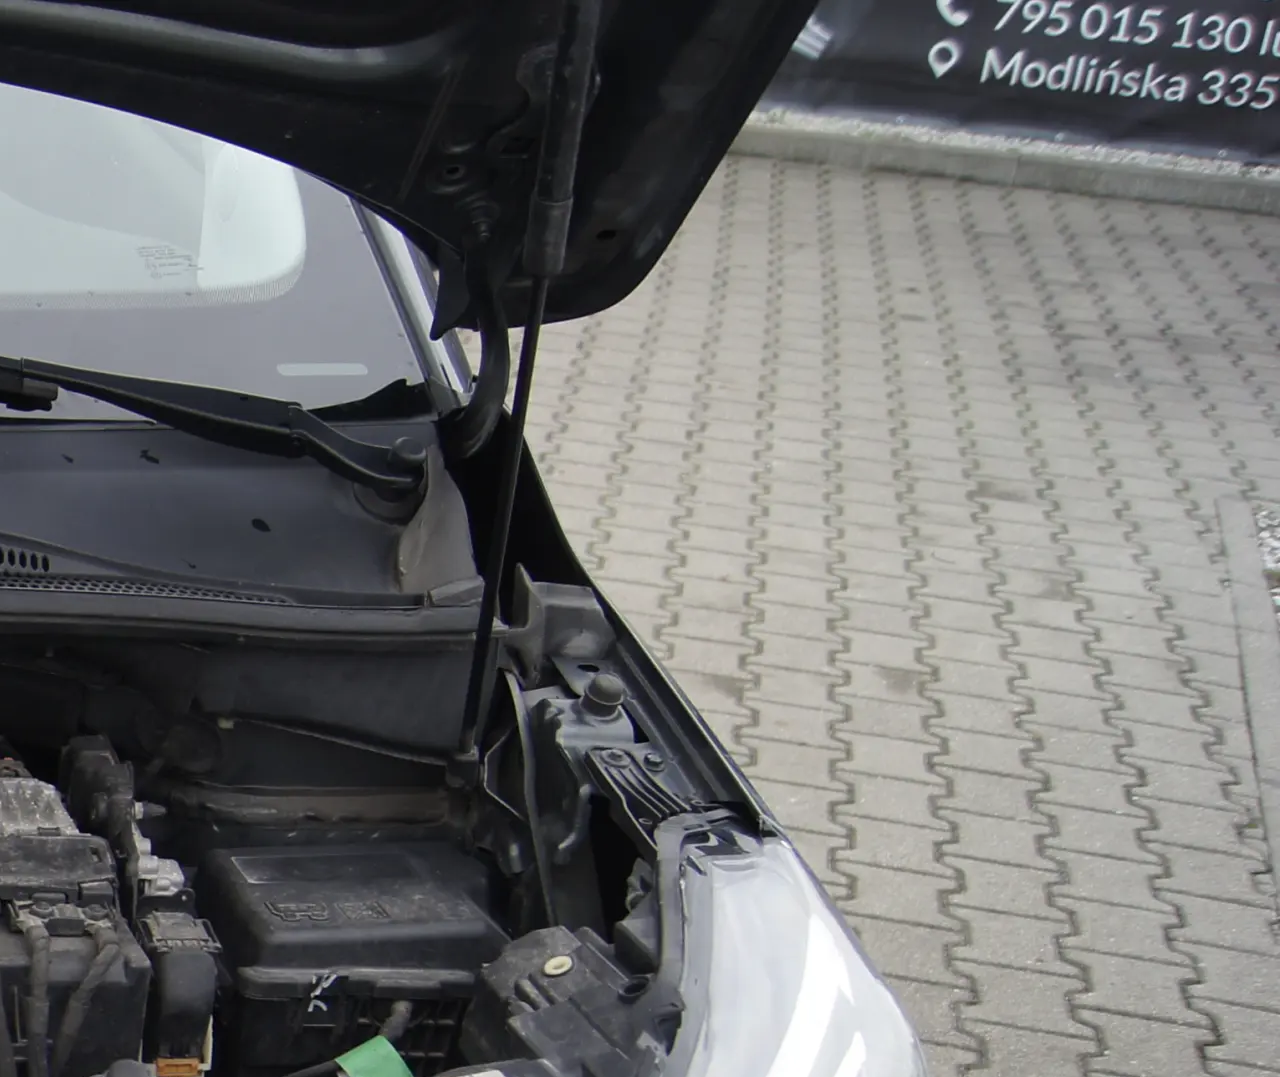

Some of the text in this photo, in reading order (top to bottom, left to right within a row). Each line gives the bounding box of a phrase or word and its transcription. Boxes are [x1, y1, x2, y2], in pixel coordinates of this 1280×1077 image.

[994, 0, 1073, 37] 795
[1079, 2, 1163, 46] 015
[1171, 11, 1254, 54] 130
[979, 47, 1280, 110] Modlińska 335
